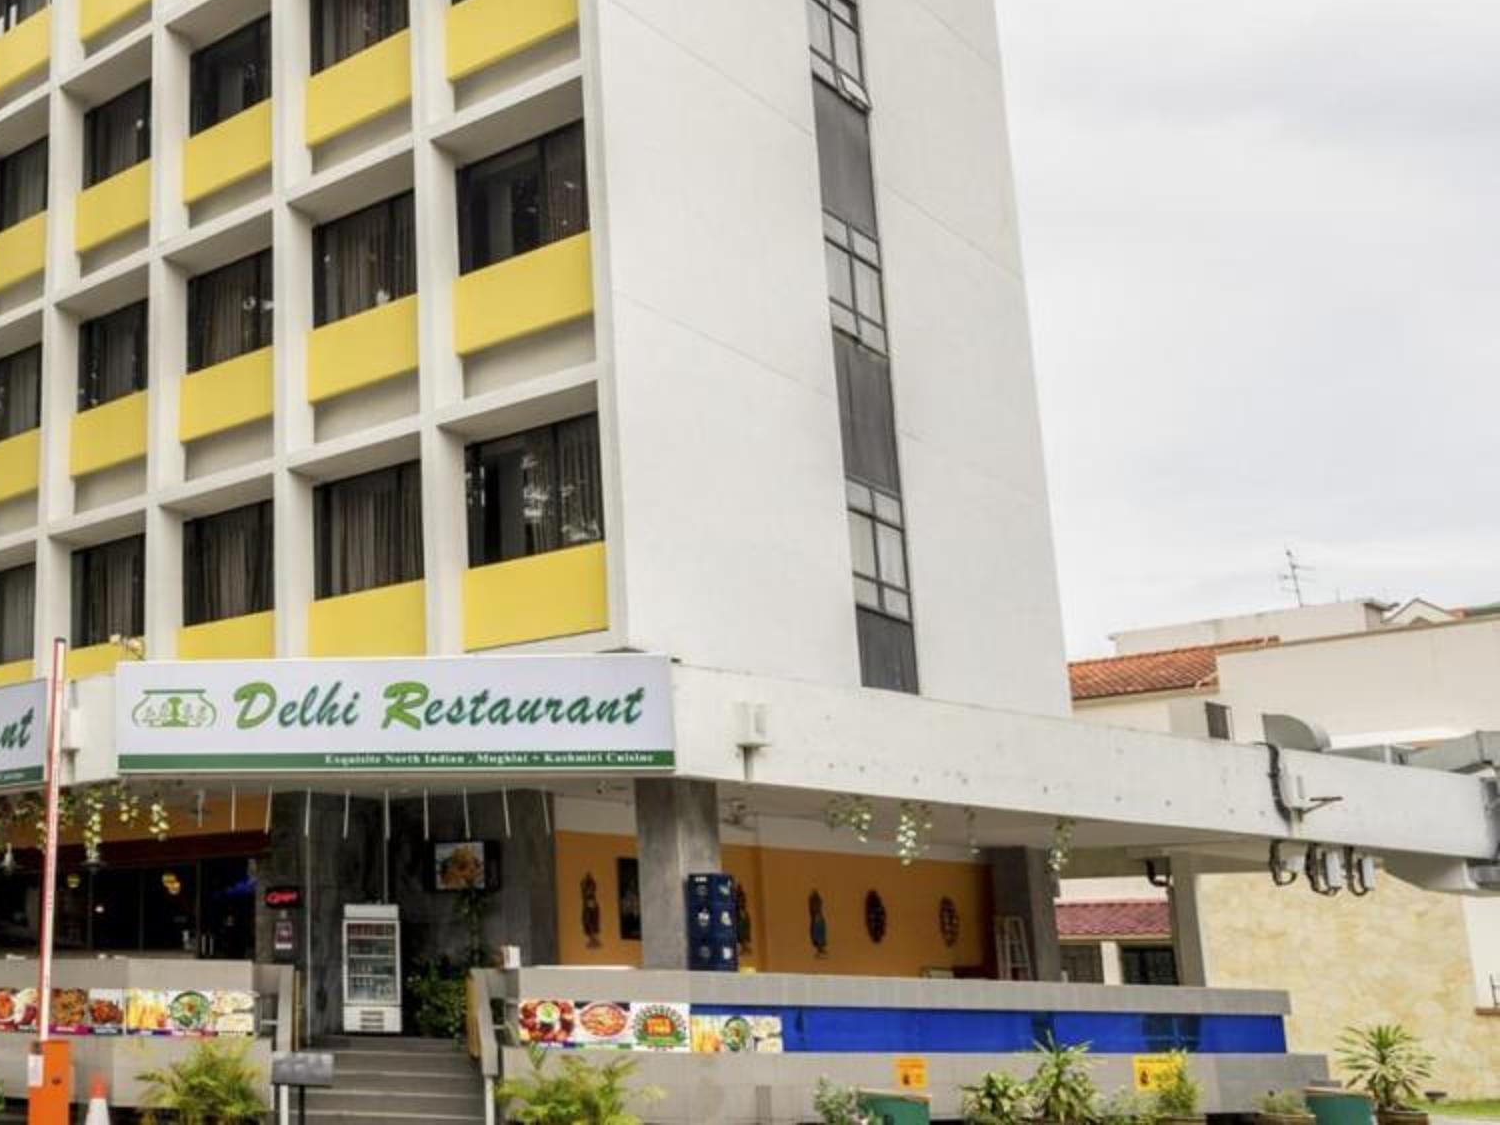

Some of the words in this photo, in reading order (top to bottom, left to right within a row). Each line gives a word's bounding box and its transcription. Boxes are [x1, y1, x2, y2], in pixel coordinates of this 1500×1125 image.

[234, 680, 360, 730] Delhi
[381, 680, 645, 731] Restaurant
[385, 754, 420, 764] North
[425, 754, 464, 764] Indian
[606, 752, 654, 763] Cuisine
